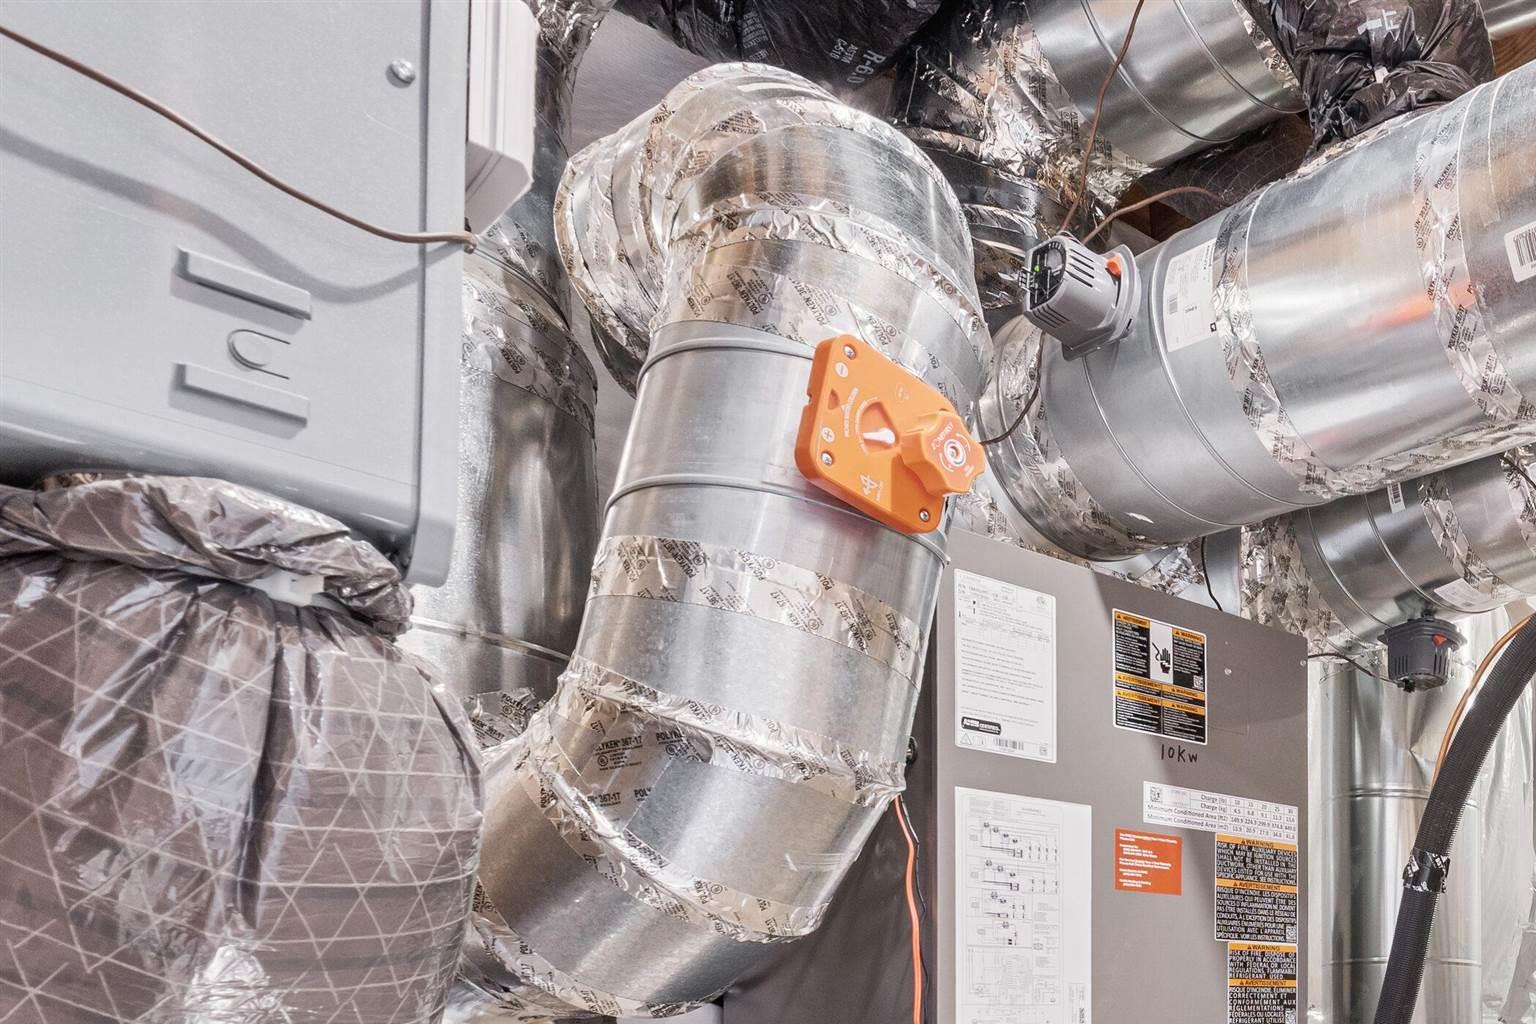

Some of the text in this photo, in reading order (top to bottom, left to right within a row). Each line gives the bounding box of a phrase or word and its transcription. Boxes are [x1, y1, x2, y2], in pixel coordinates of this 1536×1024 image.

[847, 50, 887, 84] R-6.0
[1201, 794, 1218, 803] Charge
[1200, 802, 1218, 812] Charge
[1174, 808, 1204, 818] Conditioned
[1173, 817, 1204, 828] Conditioned
